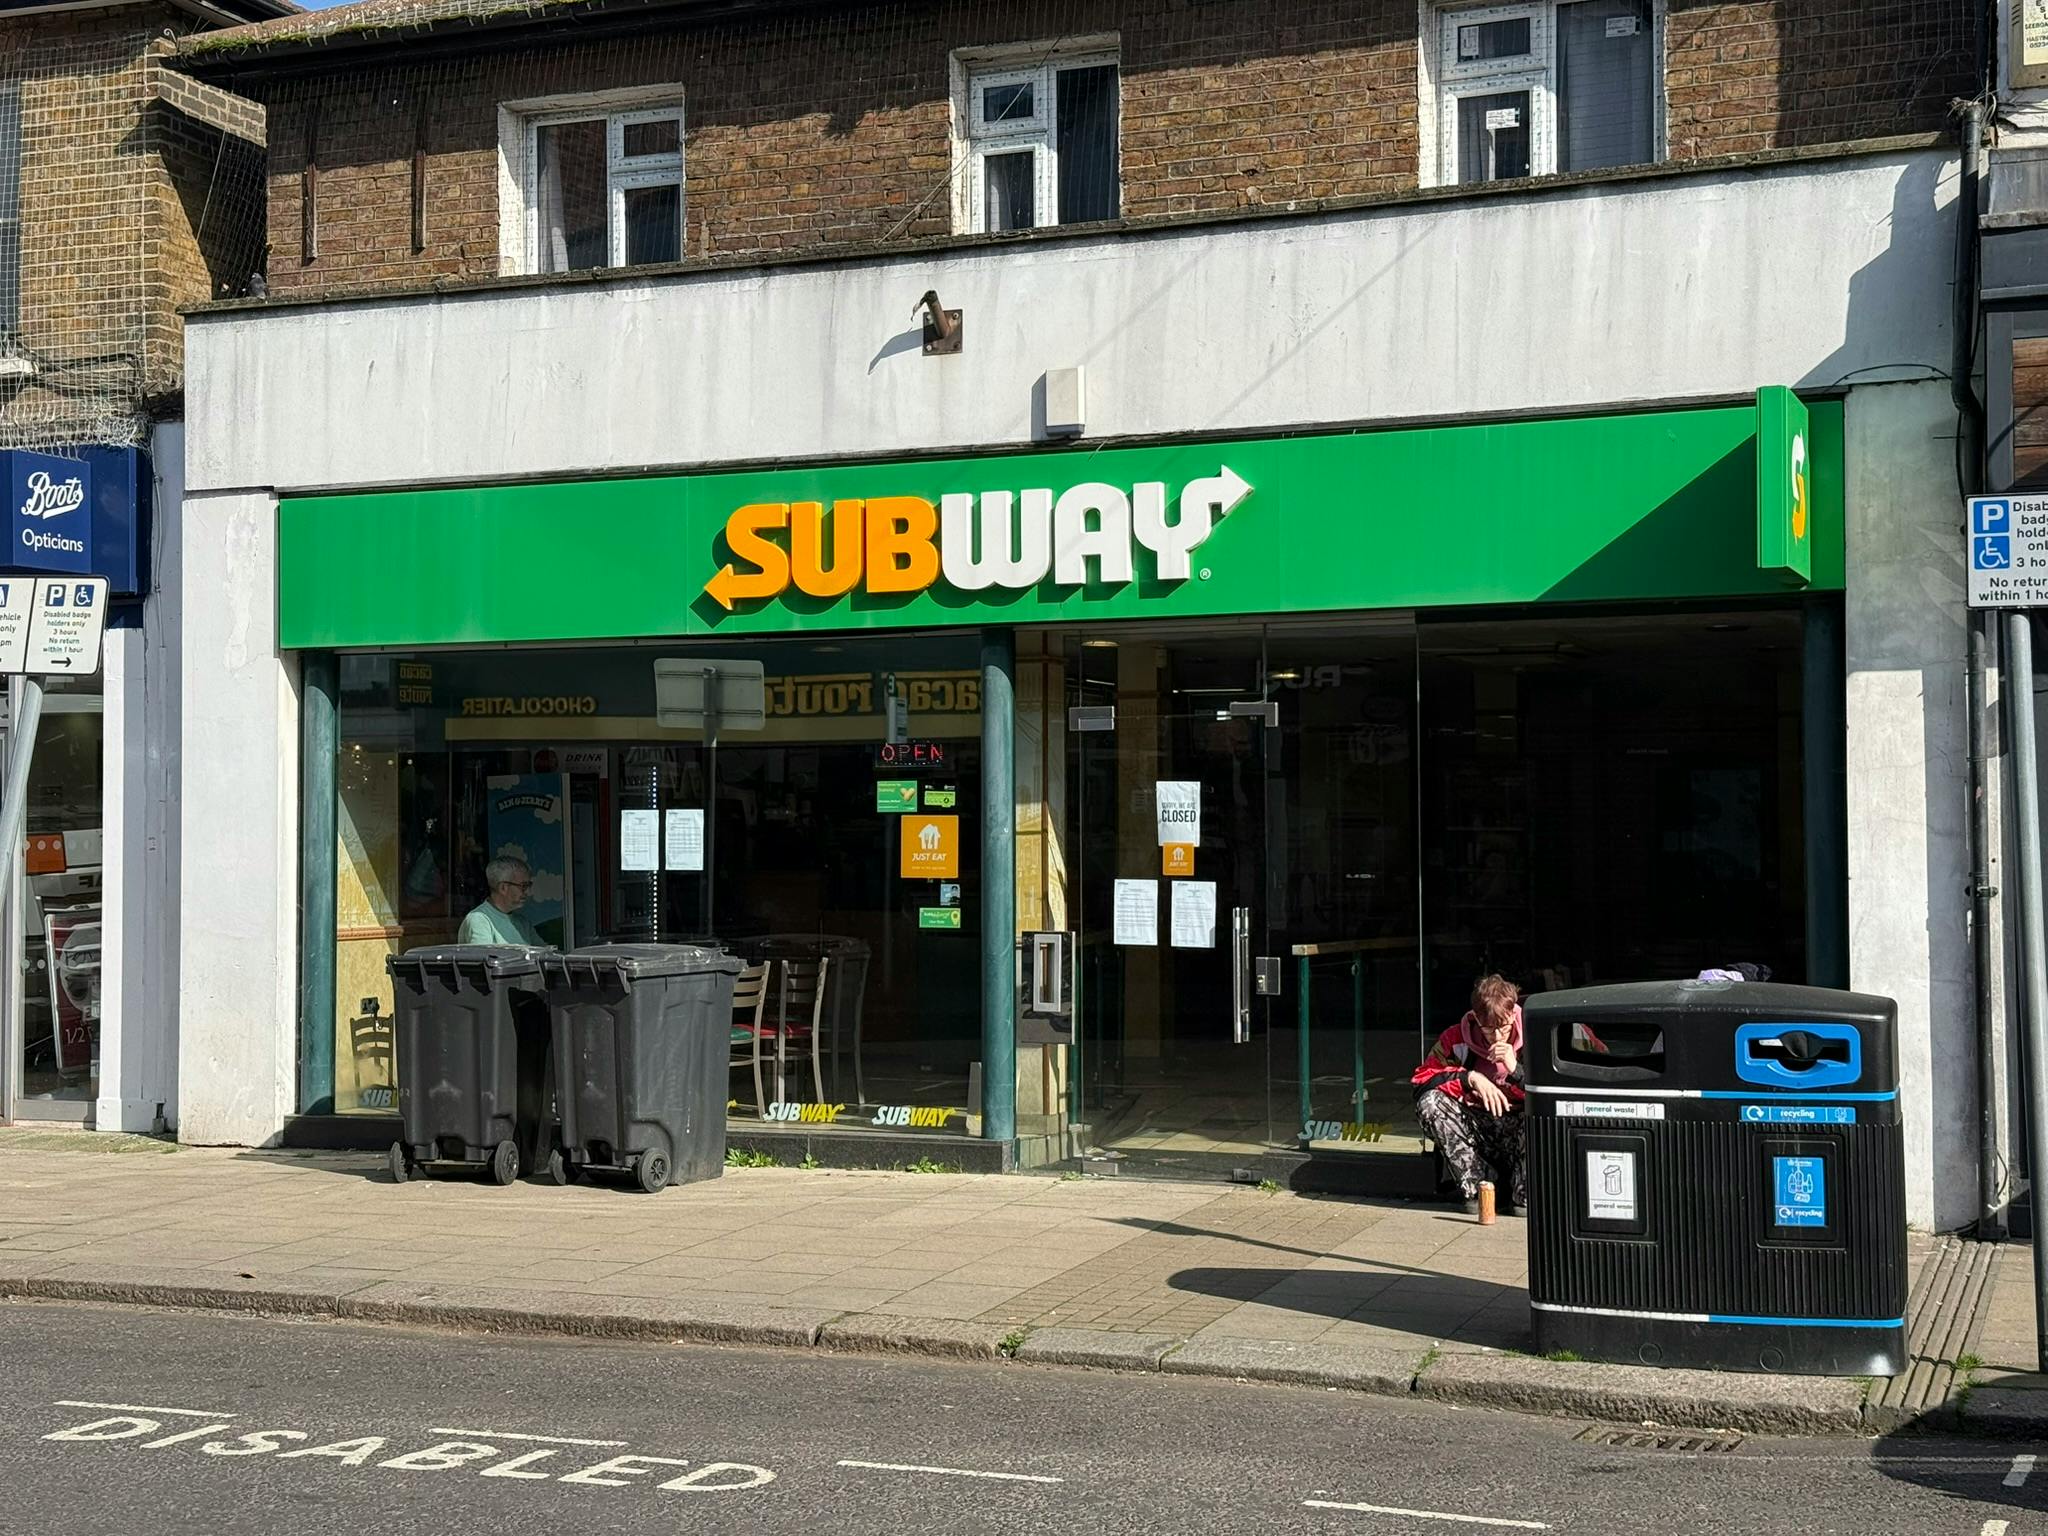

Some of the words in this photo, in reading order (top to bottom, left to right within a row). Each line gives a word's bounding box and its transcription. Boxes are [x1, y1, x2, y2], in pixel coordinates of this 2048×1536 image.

[21, 471, 84, 519] Boots
[1982, 504, 2004, 531] P
[2021, 515, 2048, 525] bad
[704, 465, 1254, 610] SUBWAY
[2017, 528, 2048, 538] hold
[22, 529, 84, 552] Opticians
[2017, 557, 2025, 568] 3
[1990, 578, 2008, 587] No
[1979, 590, 2020, 601] within
[2026, 590, 2030, 599] 1
[72, 611, 91, 619] badge
[72, 620, 86, 628] only
[60, 628, 77, 636] hours
[881, 744, 943, 761] OPEN
[1161, 809, 1197, 823] CLOSED
[912, 853, 930, 862] JUST
[932, 853, 947, 861] EAT
[763, 1102, 845, 1123] SUBWAY
[1585, 1105, 1612, 1113] general
[1614, 1106, 1635, 1114] waste
[1780, 1109, 1815, 1119] recycling
[872, 1105, 957, 1127] SUBWAY
[1297, 1120, 1393, 1143] SUBWAY
[1795, 1209, 1823, 1218] recycling
[42, 1416, 777, 1493] DISABLED
